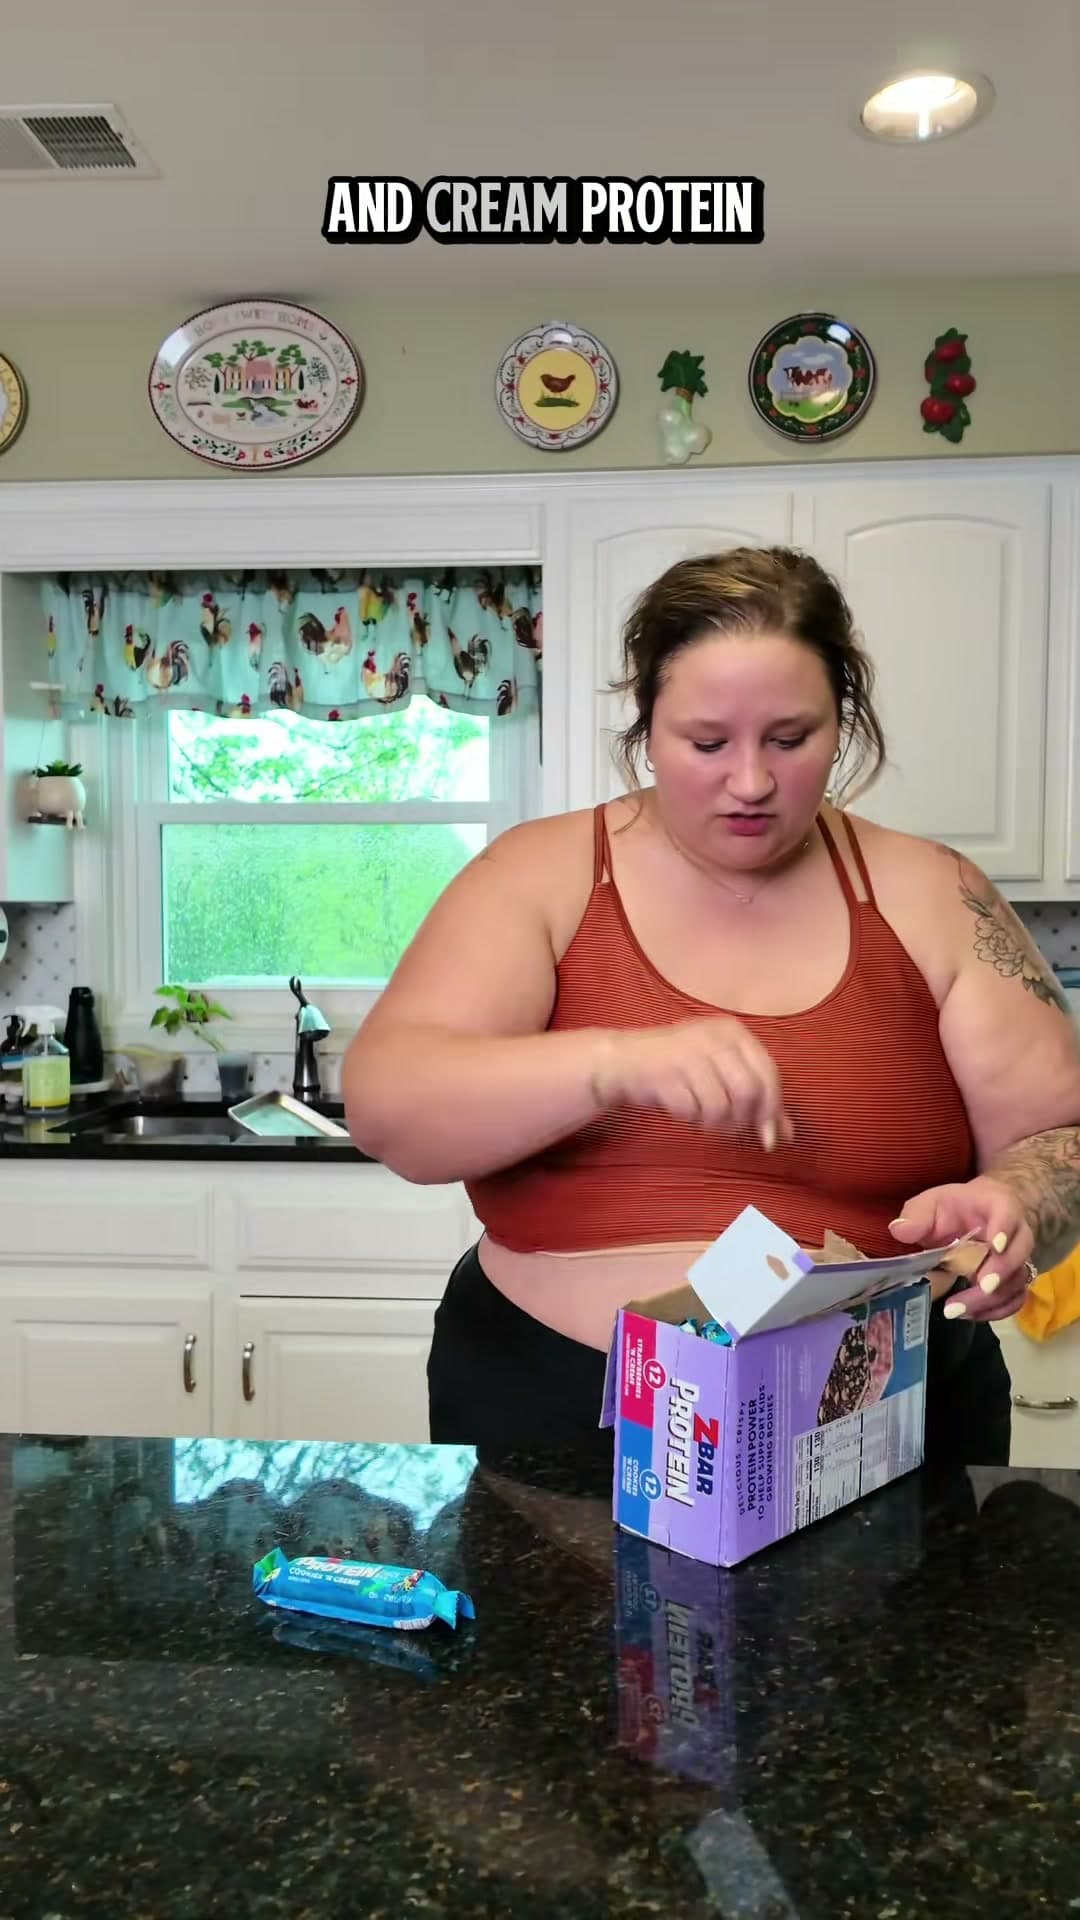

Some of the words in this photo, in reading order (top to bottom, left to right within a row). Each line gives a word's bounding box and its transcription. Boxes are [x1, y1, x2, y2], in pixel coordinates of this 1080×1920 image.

[635, 1338, 643, 1399] STRAWBERRIES
[649, 1365, 661, 1385] 12
[736, 1400, 746, 1444] CRISPY
[747, 1399, 757, 1450] POWER
[766, 1393, 774, 1438] BODIES
[665, 1376, 700, 1509] PROTEIN
[693, 1410, 719, 1496] ZBAR
[758, 1417, 766, 1470] SUPPORT
[644, 1476, 656, 1495] 12
[747, 1453, 757, 1511] PROTEIN
[766, 1441, 774, 1502] GROWING
[758, 1504, 765, 1520] TO
[289, 1567, 323, 1581] COOKIES
